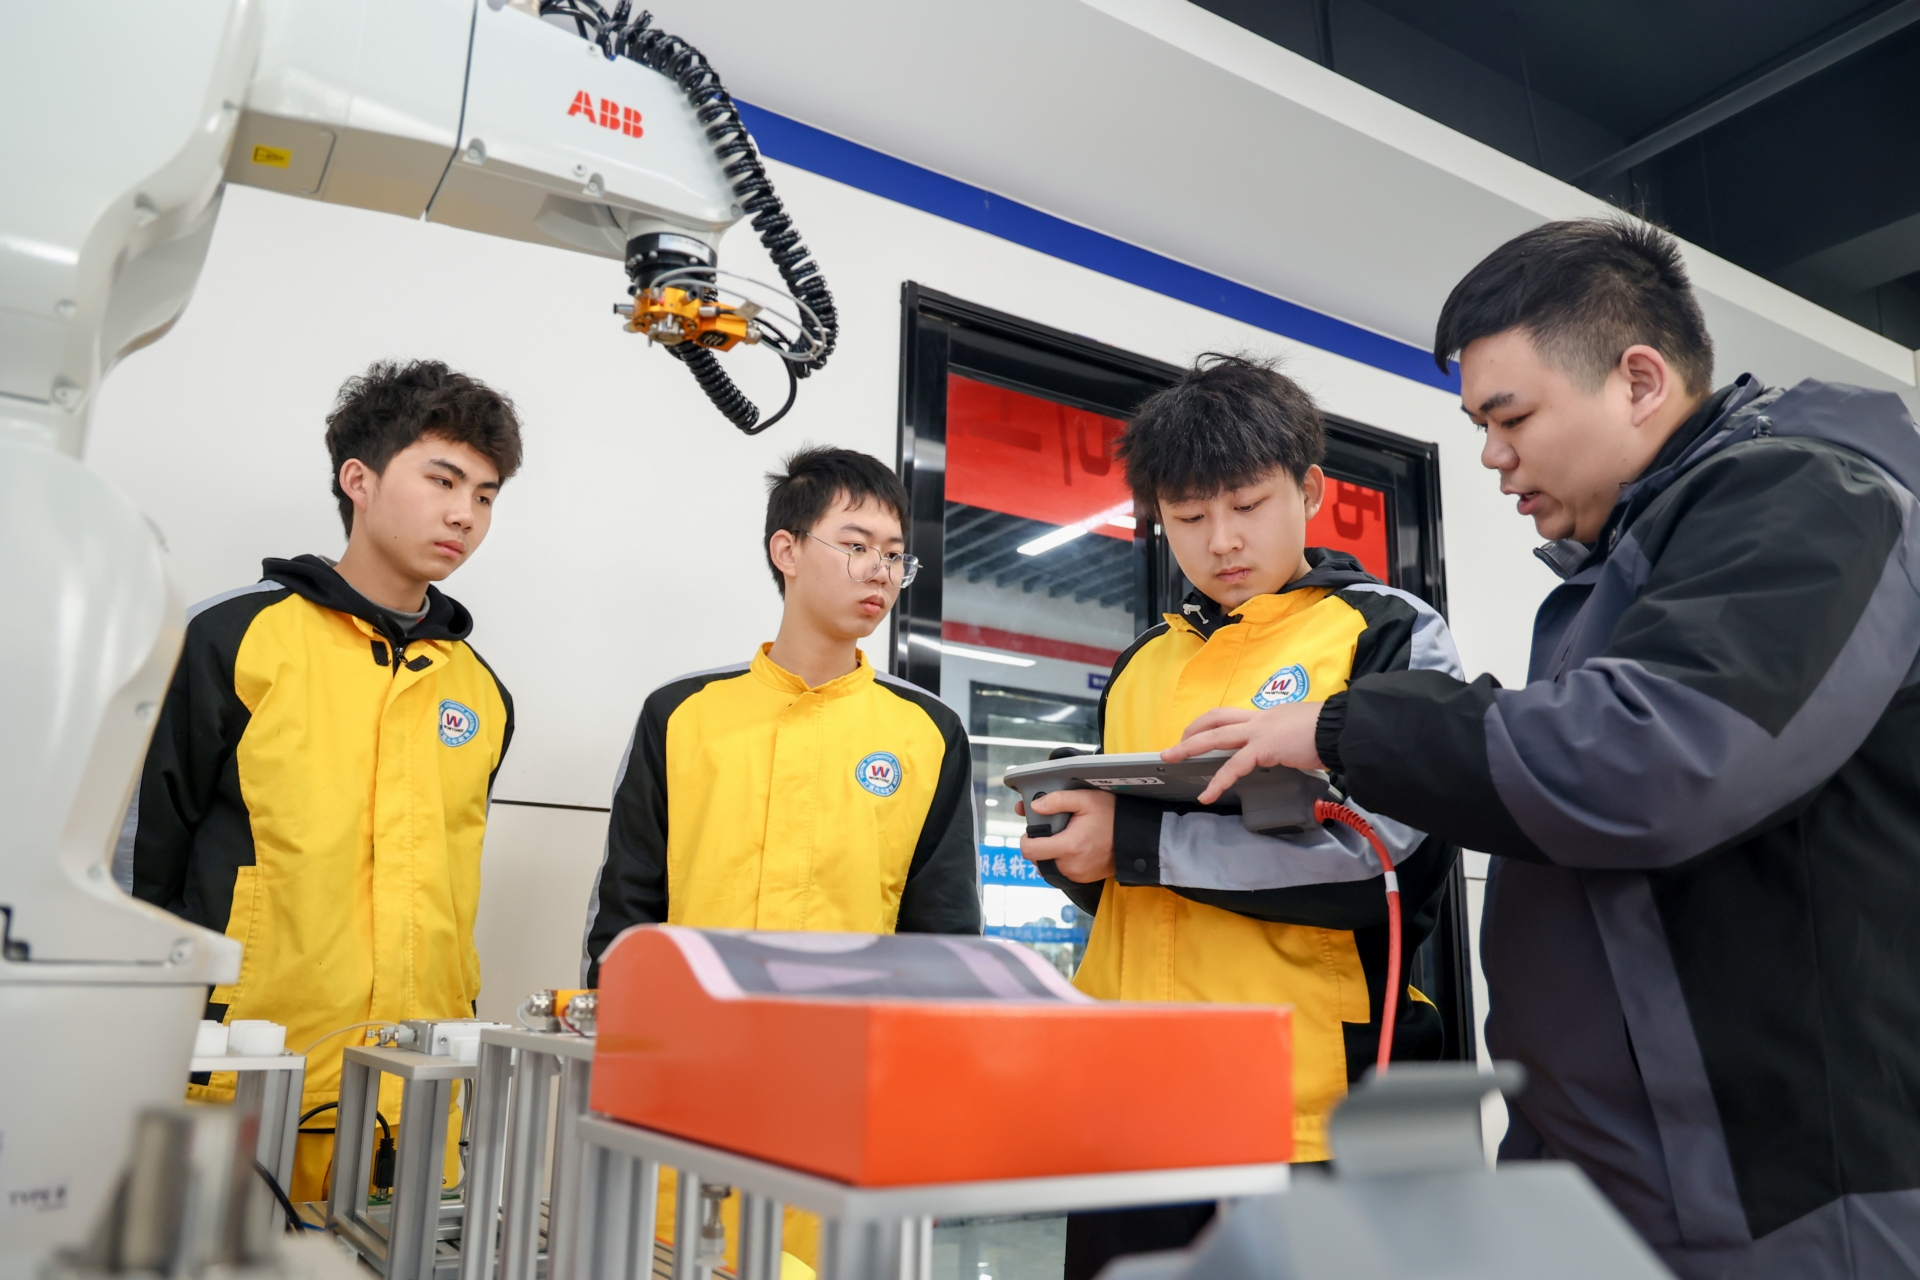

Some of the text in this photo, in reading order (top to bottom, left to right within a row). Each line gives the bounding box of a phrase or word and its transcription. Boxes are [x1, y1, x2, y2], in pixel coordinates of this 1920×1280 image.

[567, 90, 643, 138] ABB
[1271, 679, 1292, 691] W
[446, 712, 463, 728] W
[871, 765, 890, 778] W
